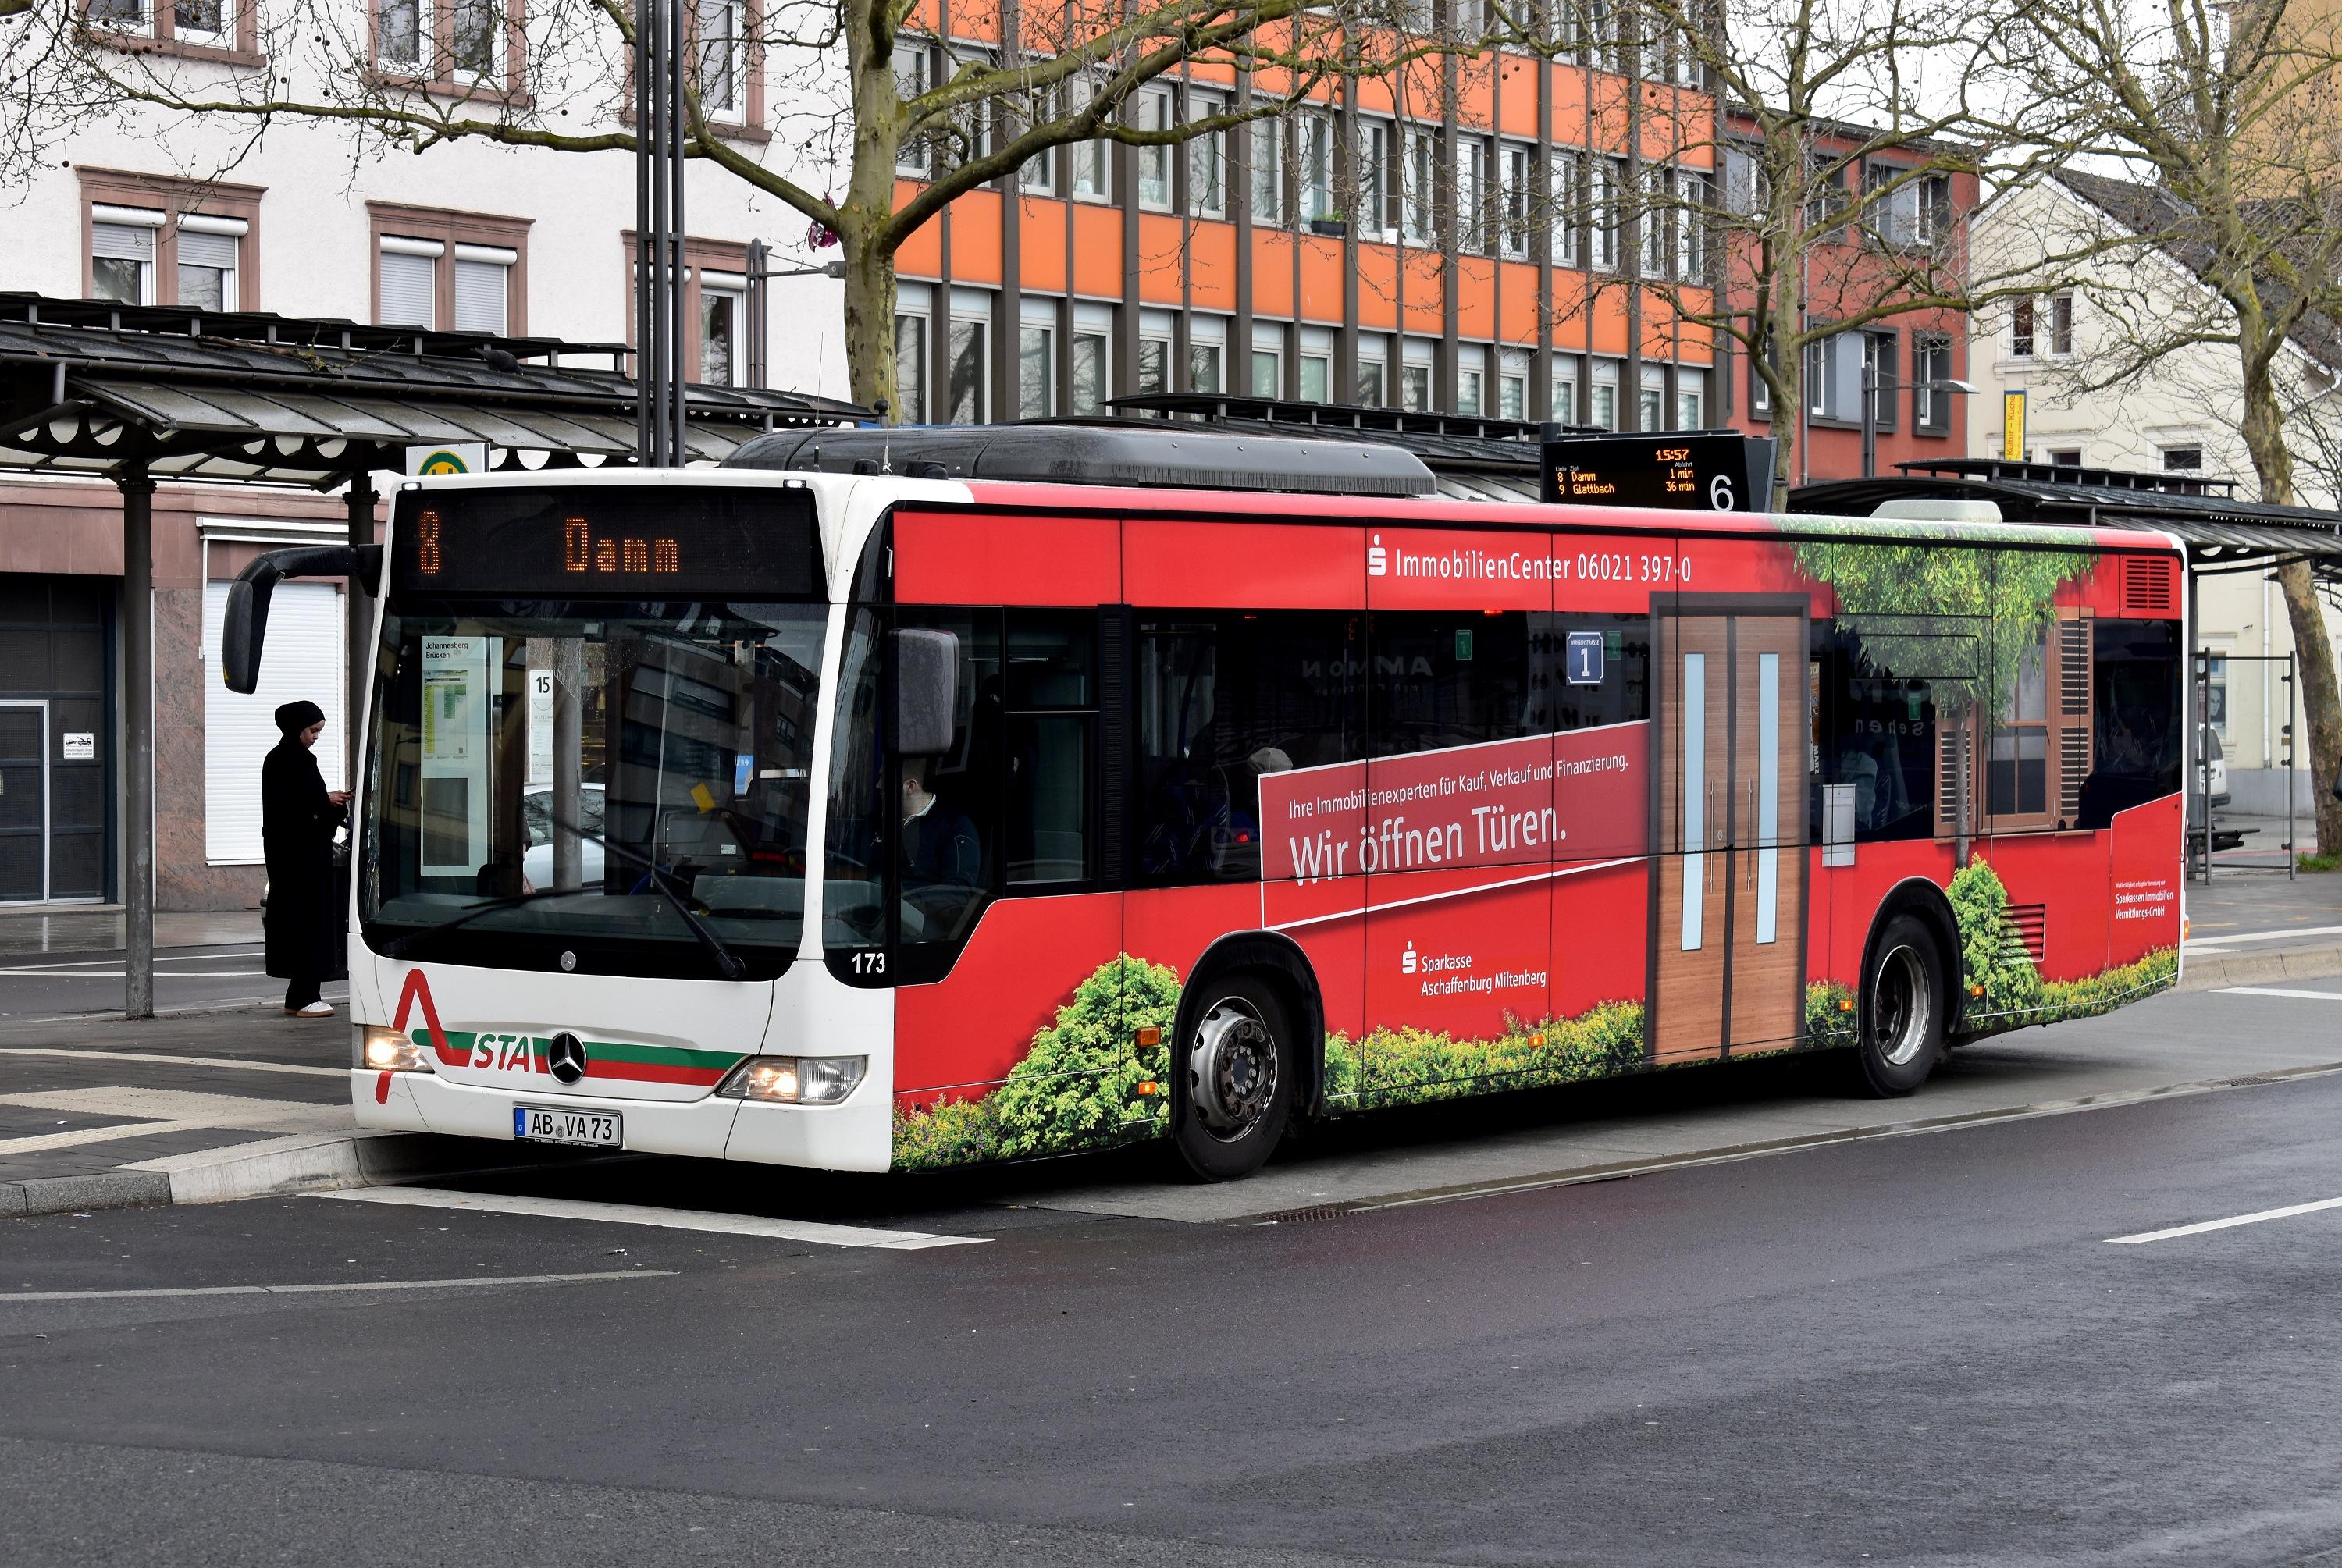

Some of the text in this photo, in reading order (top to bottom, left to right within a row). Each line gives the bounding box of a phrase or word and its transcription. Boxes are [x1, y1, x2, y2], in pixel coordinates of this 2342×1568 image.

[2007, 395, 2016, 421] Küche
[1655, 449, 1689, 462] 15:57
[1557, 469, 1694, 482] 8 Damm 1 min
[1558, 481, 1695, 495] 9 Glattbach 36 min
[1710, 475, 1735, 512] 6
[420, 511, 679, 574] 8 Damm
[1396, 549, 1571, 581] ImmobilienCenter
[1578, 553, 1633, 581] 06021
[1640, 556, 1692, 583] 397-0
[425, 642, 468, 650] Johannesberg
[1580, 648, 1590, 677] 1
[536, 677, 550, 693] 15
[1289, 752, 1628, 819] Ihre Immobilienexperten für Kauf, Verkauf und Finanzierung.
[1290, 804, 1567, 887] Wir öffnen Türen.
[2116, 891, 2173, 906] Sparkassen Immobilien
[2116, 906, 2166, 920] Vermittlungs-GmbH
[852, 952, 885, 974] 173
[1422, 954, 1472, 974] Sparkasse
[1421, 969, 1547, 997] Aschaffenburg Miltenberg
[532, 1114, 613, 1140] AB VA 73
